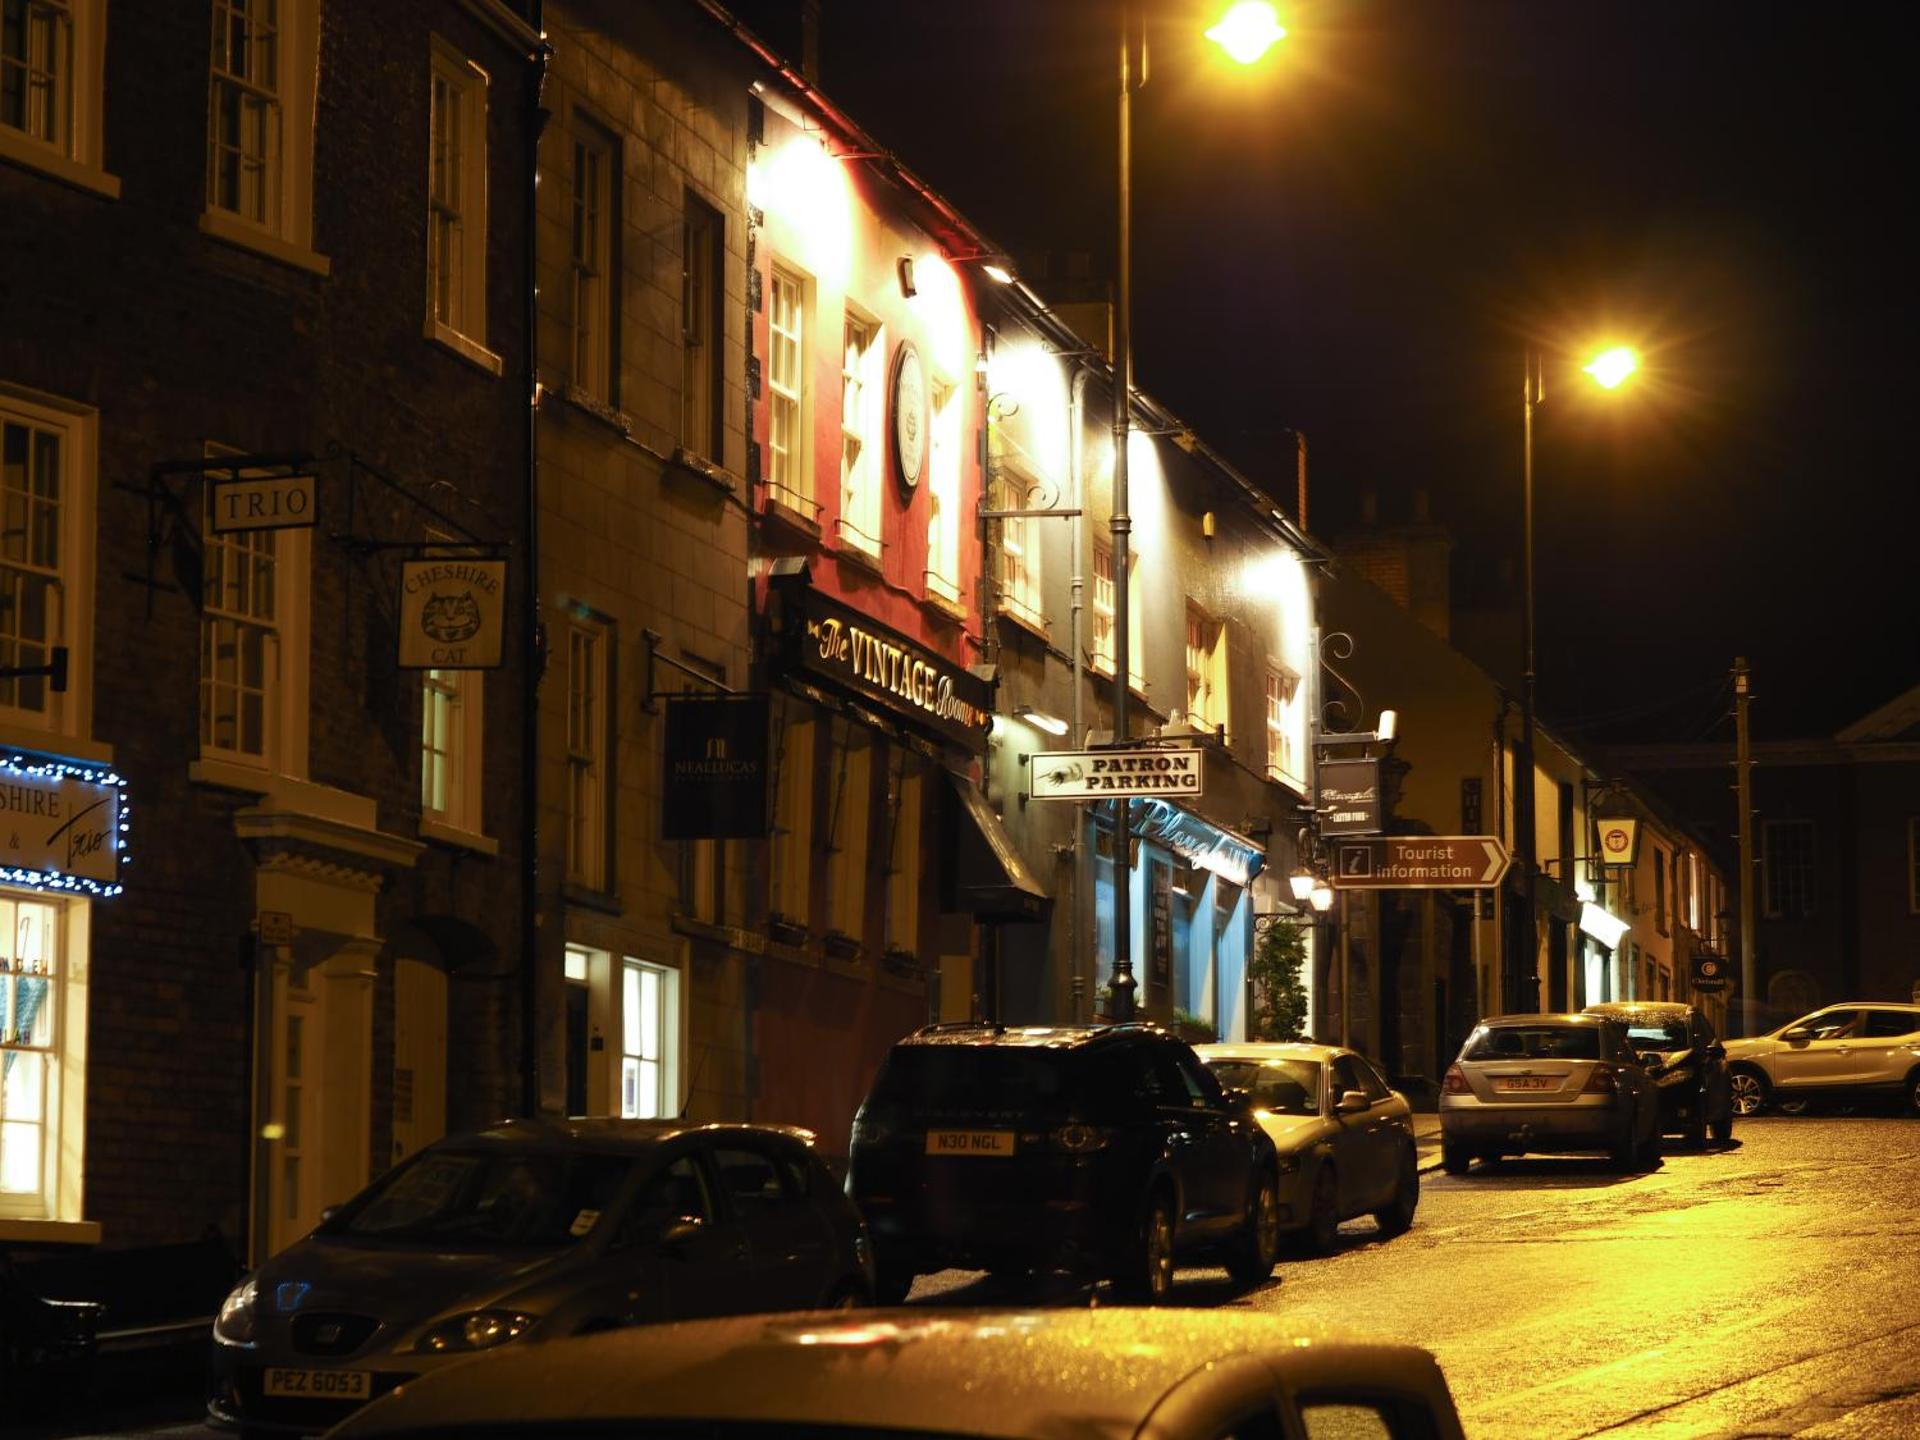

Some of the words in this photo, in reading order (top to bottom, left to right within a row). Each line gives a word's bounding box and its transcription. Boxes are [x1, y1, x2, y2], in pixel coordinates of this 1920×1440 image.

[224, 488, 307, 519] TRIO
[404, 564, 498, 594] CHESHIRE
[431, 648, 468, 664] CAT
[819, 617, 850, 662] The
[849, 626, 937, 713] VINTAGE
[1092, 757, 1190, 773] PATRON
[1085, 774, 1196, 790] PARKING
[1396, 846, 1454, 860] Tourist
[1376, 864, 1473, 878] information
[938, 1134, 968, 1149] N30
[971, 1135, 1001, 1150] NGL
[272, 1370, 306, 1392] PEZ
